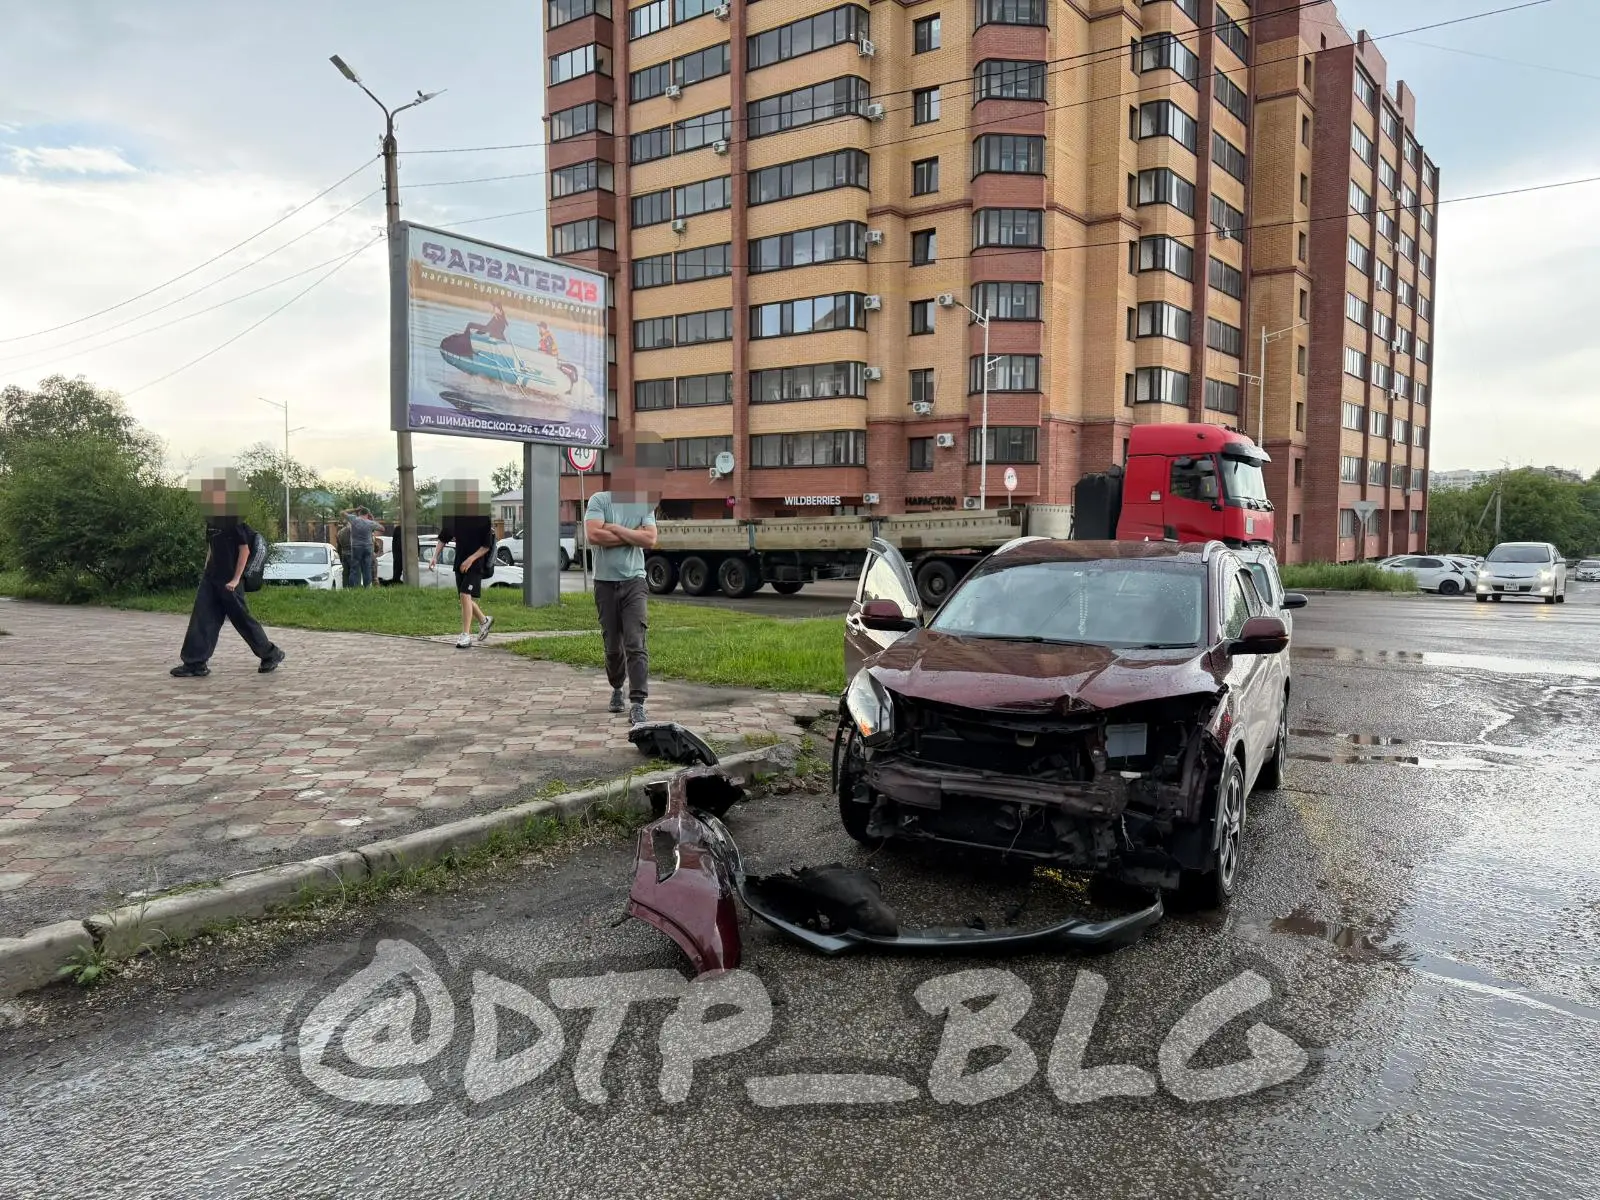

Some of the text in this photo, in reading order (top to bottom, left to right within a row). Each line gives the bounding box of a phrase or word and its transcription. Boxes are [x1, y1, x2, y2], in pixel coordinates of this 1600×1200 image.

[421, 271, 470, 289] магазин
[420, 414, 434, 425] ул.
[436, 415, 517, 432] ШИМАНОВСКОГО
[541, 424, 587, 440] 42-02-42
[574, 447, 590, 460] 40
[784, 496, 841, 506] WILDBERRIES
